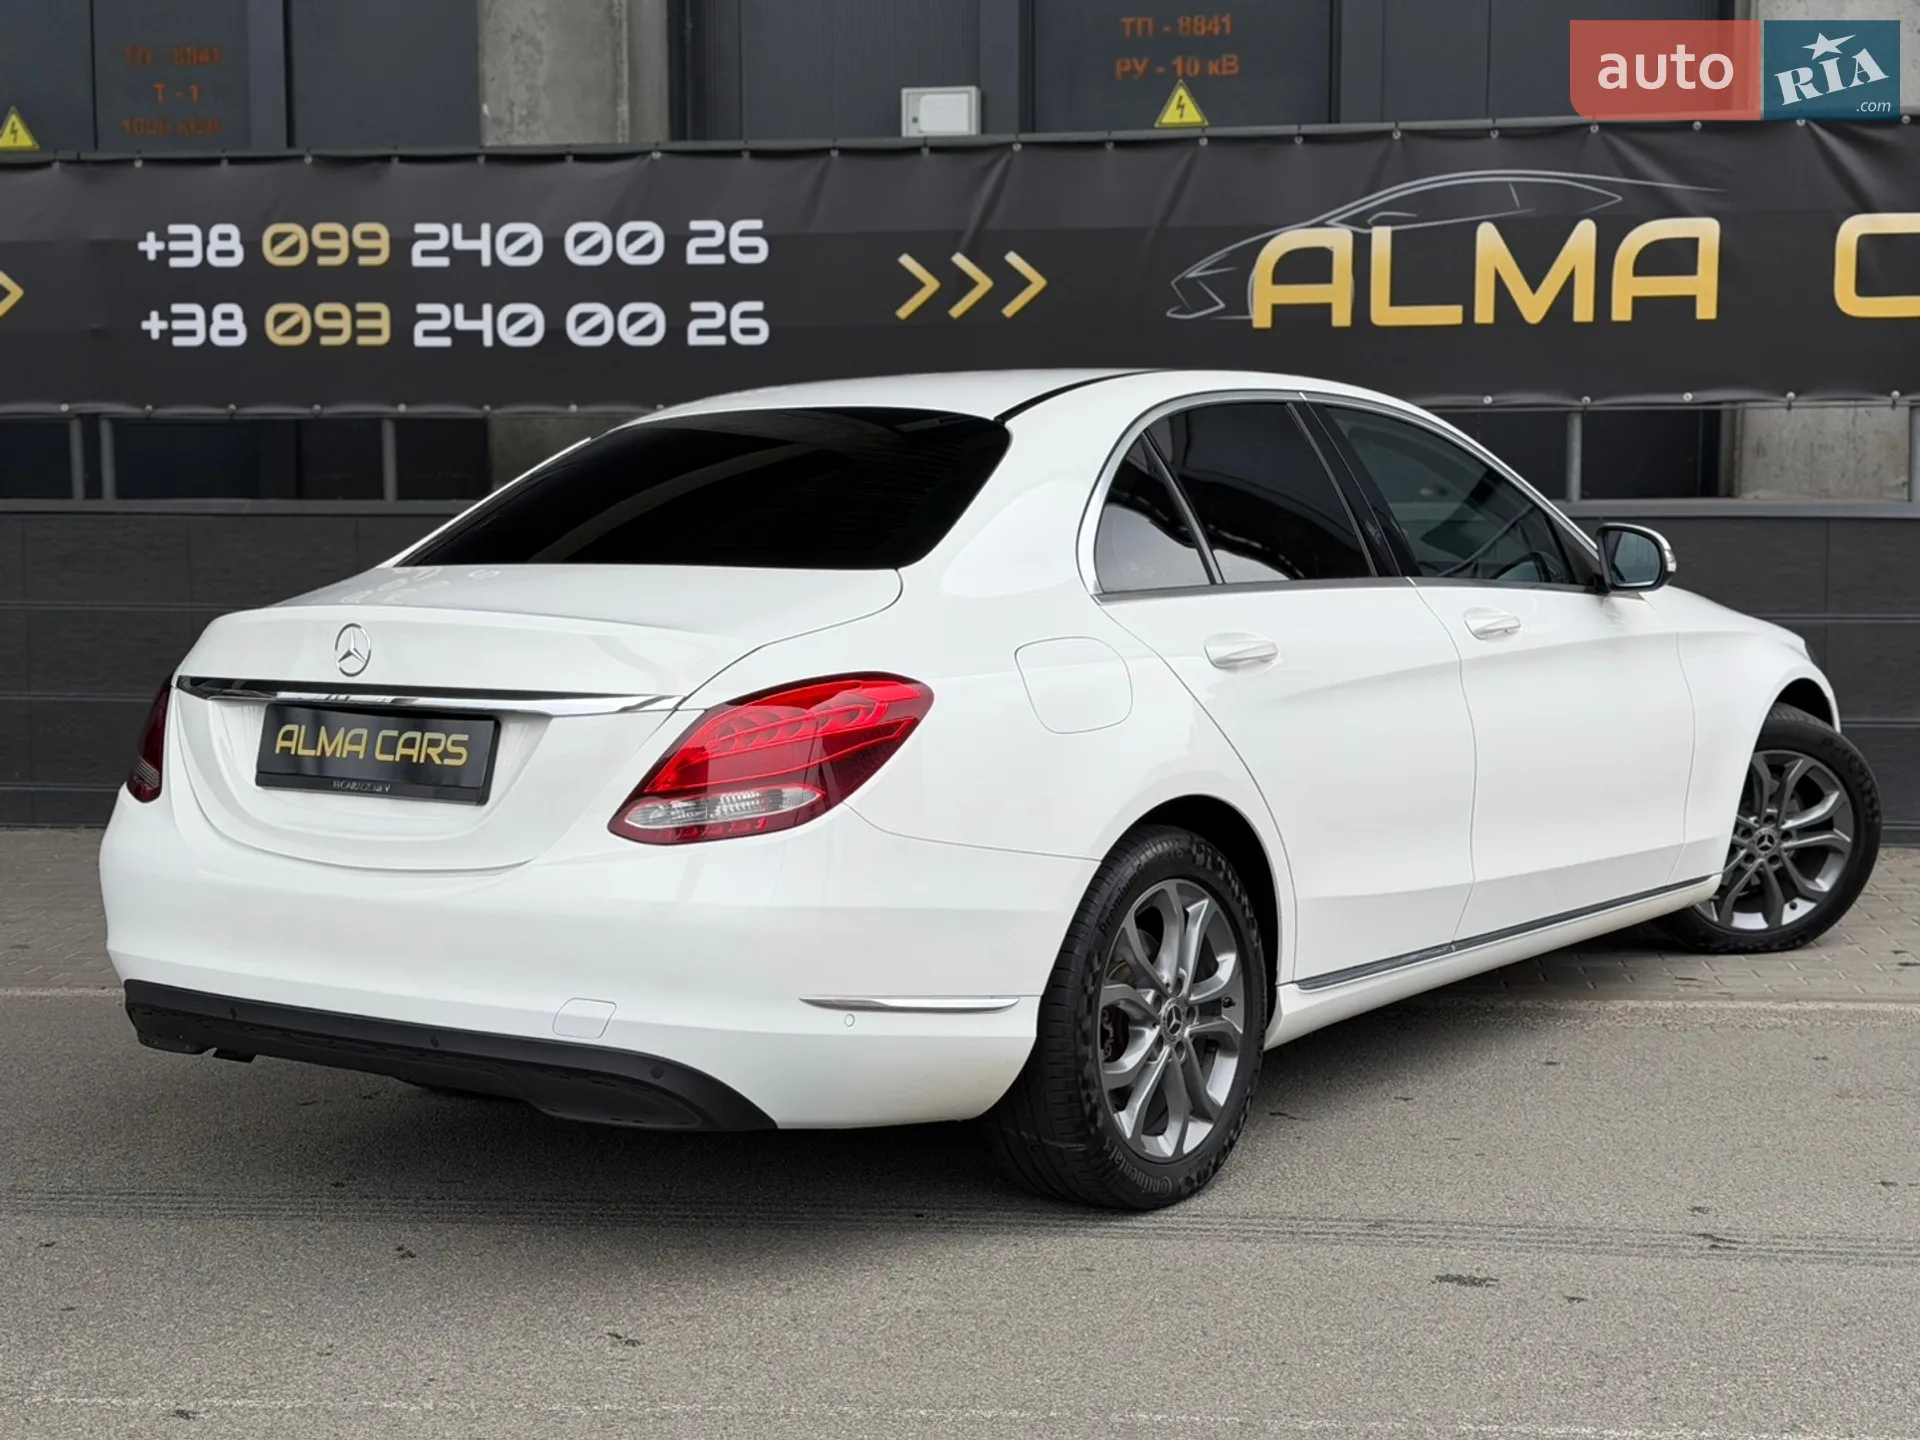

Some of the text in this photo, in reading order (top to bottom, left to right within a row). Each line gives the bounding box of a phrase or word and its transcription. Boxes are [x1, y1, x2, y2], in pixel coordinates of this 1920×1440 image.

[1120, 16, 1155, 38] ТП
[1178, 13, 1233, 37] 8841
[1115, 57, 1150, 80] РУ
[1172, 55, 1201, 77] 10
[137, 219, 769, 268] +38 099 240 00 26
[1252, 217, 1720, 328] ALMA
[141, 301, 770, 347] +38 093 240 00 26
[275, 724, 469, 767] ALMA CARS
